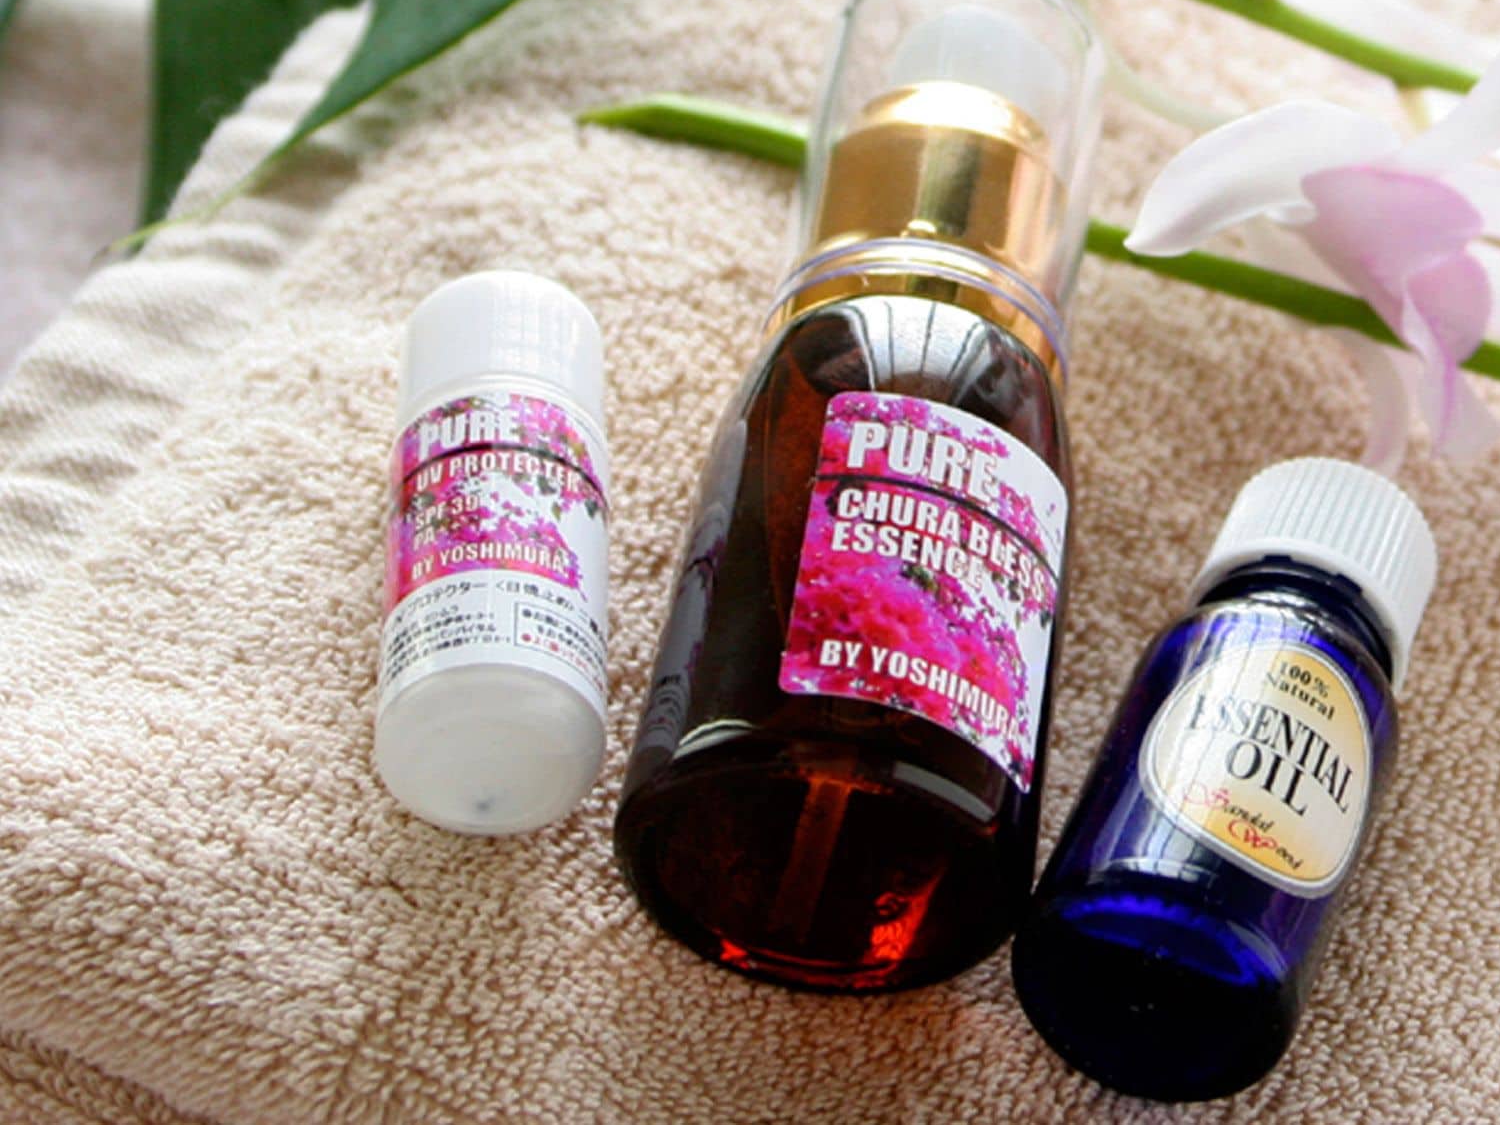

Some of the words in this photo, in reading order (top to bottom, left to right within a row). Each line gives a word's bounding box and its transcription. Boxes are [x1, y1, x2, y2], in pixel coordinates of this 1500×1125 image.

[419, 409, 521, 459] PURE
[846, 421, 1000, 503] PURE
[416, 464, 445, 491] UV
[831, 521, 986, 592] ESSENCE
[837, 487, 961, 543] CHURA
[969, 526, 1046, 603] BLESS
[820, 639, 863, 669] BY
[869, 646, 1019, 741] YOSHIMURA
[1264, 672, 1337, 721] Natural
[1278, 661, 1331, 699] 100%
[1184, 692, 1353, 815] ESSENTIAL
[1224, 740, 1309, 817] OIL
